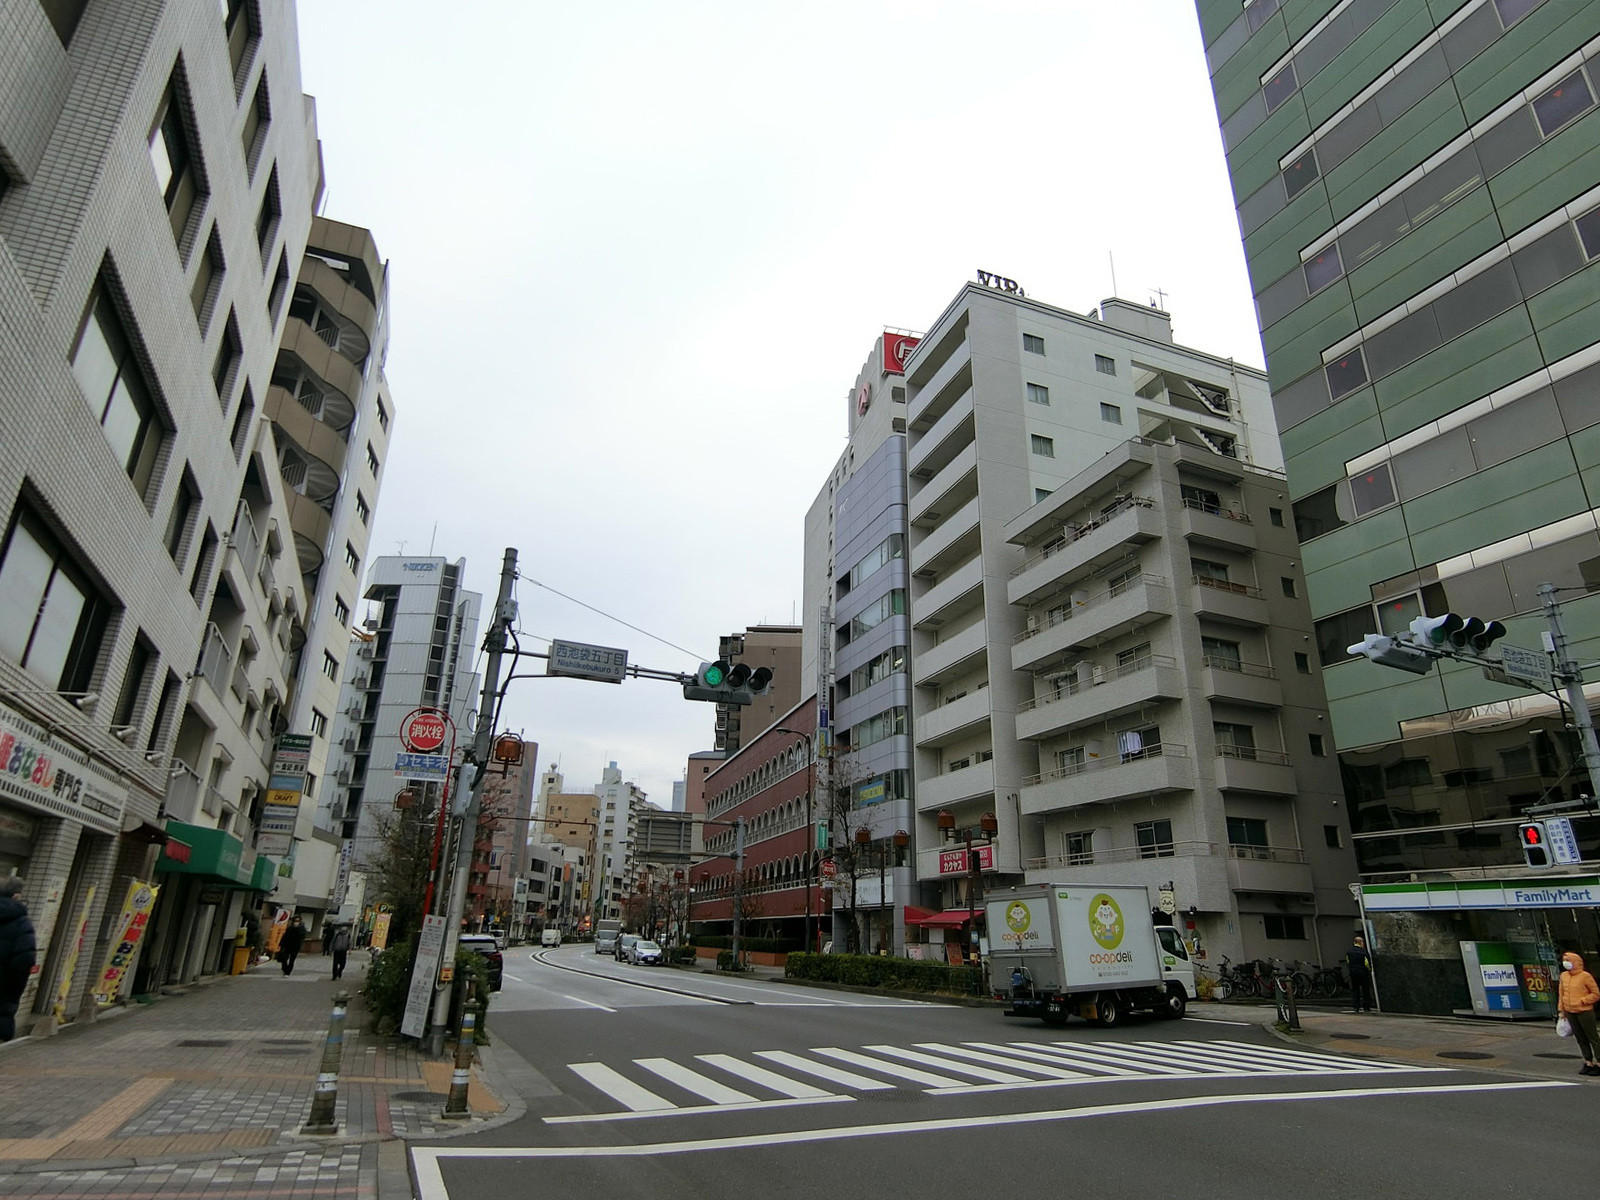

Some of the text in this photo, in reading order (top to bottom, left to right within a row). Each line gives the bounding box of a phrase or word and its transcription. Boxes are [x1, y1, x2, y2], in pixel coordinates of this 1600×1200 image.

[556, 644, 624, 666] 西池袋五丁目
[411, 724, 443, 740] 消火栓
[0, 727, 83, 804] 服おなおし専門店
[410, 754, 448, 768] セキネ
[943, 860, 963, 872] カクヤス
[1514, 889, 1592, 903] FamilyMart
[1484, 969, 1516, 981] FamilyMart
